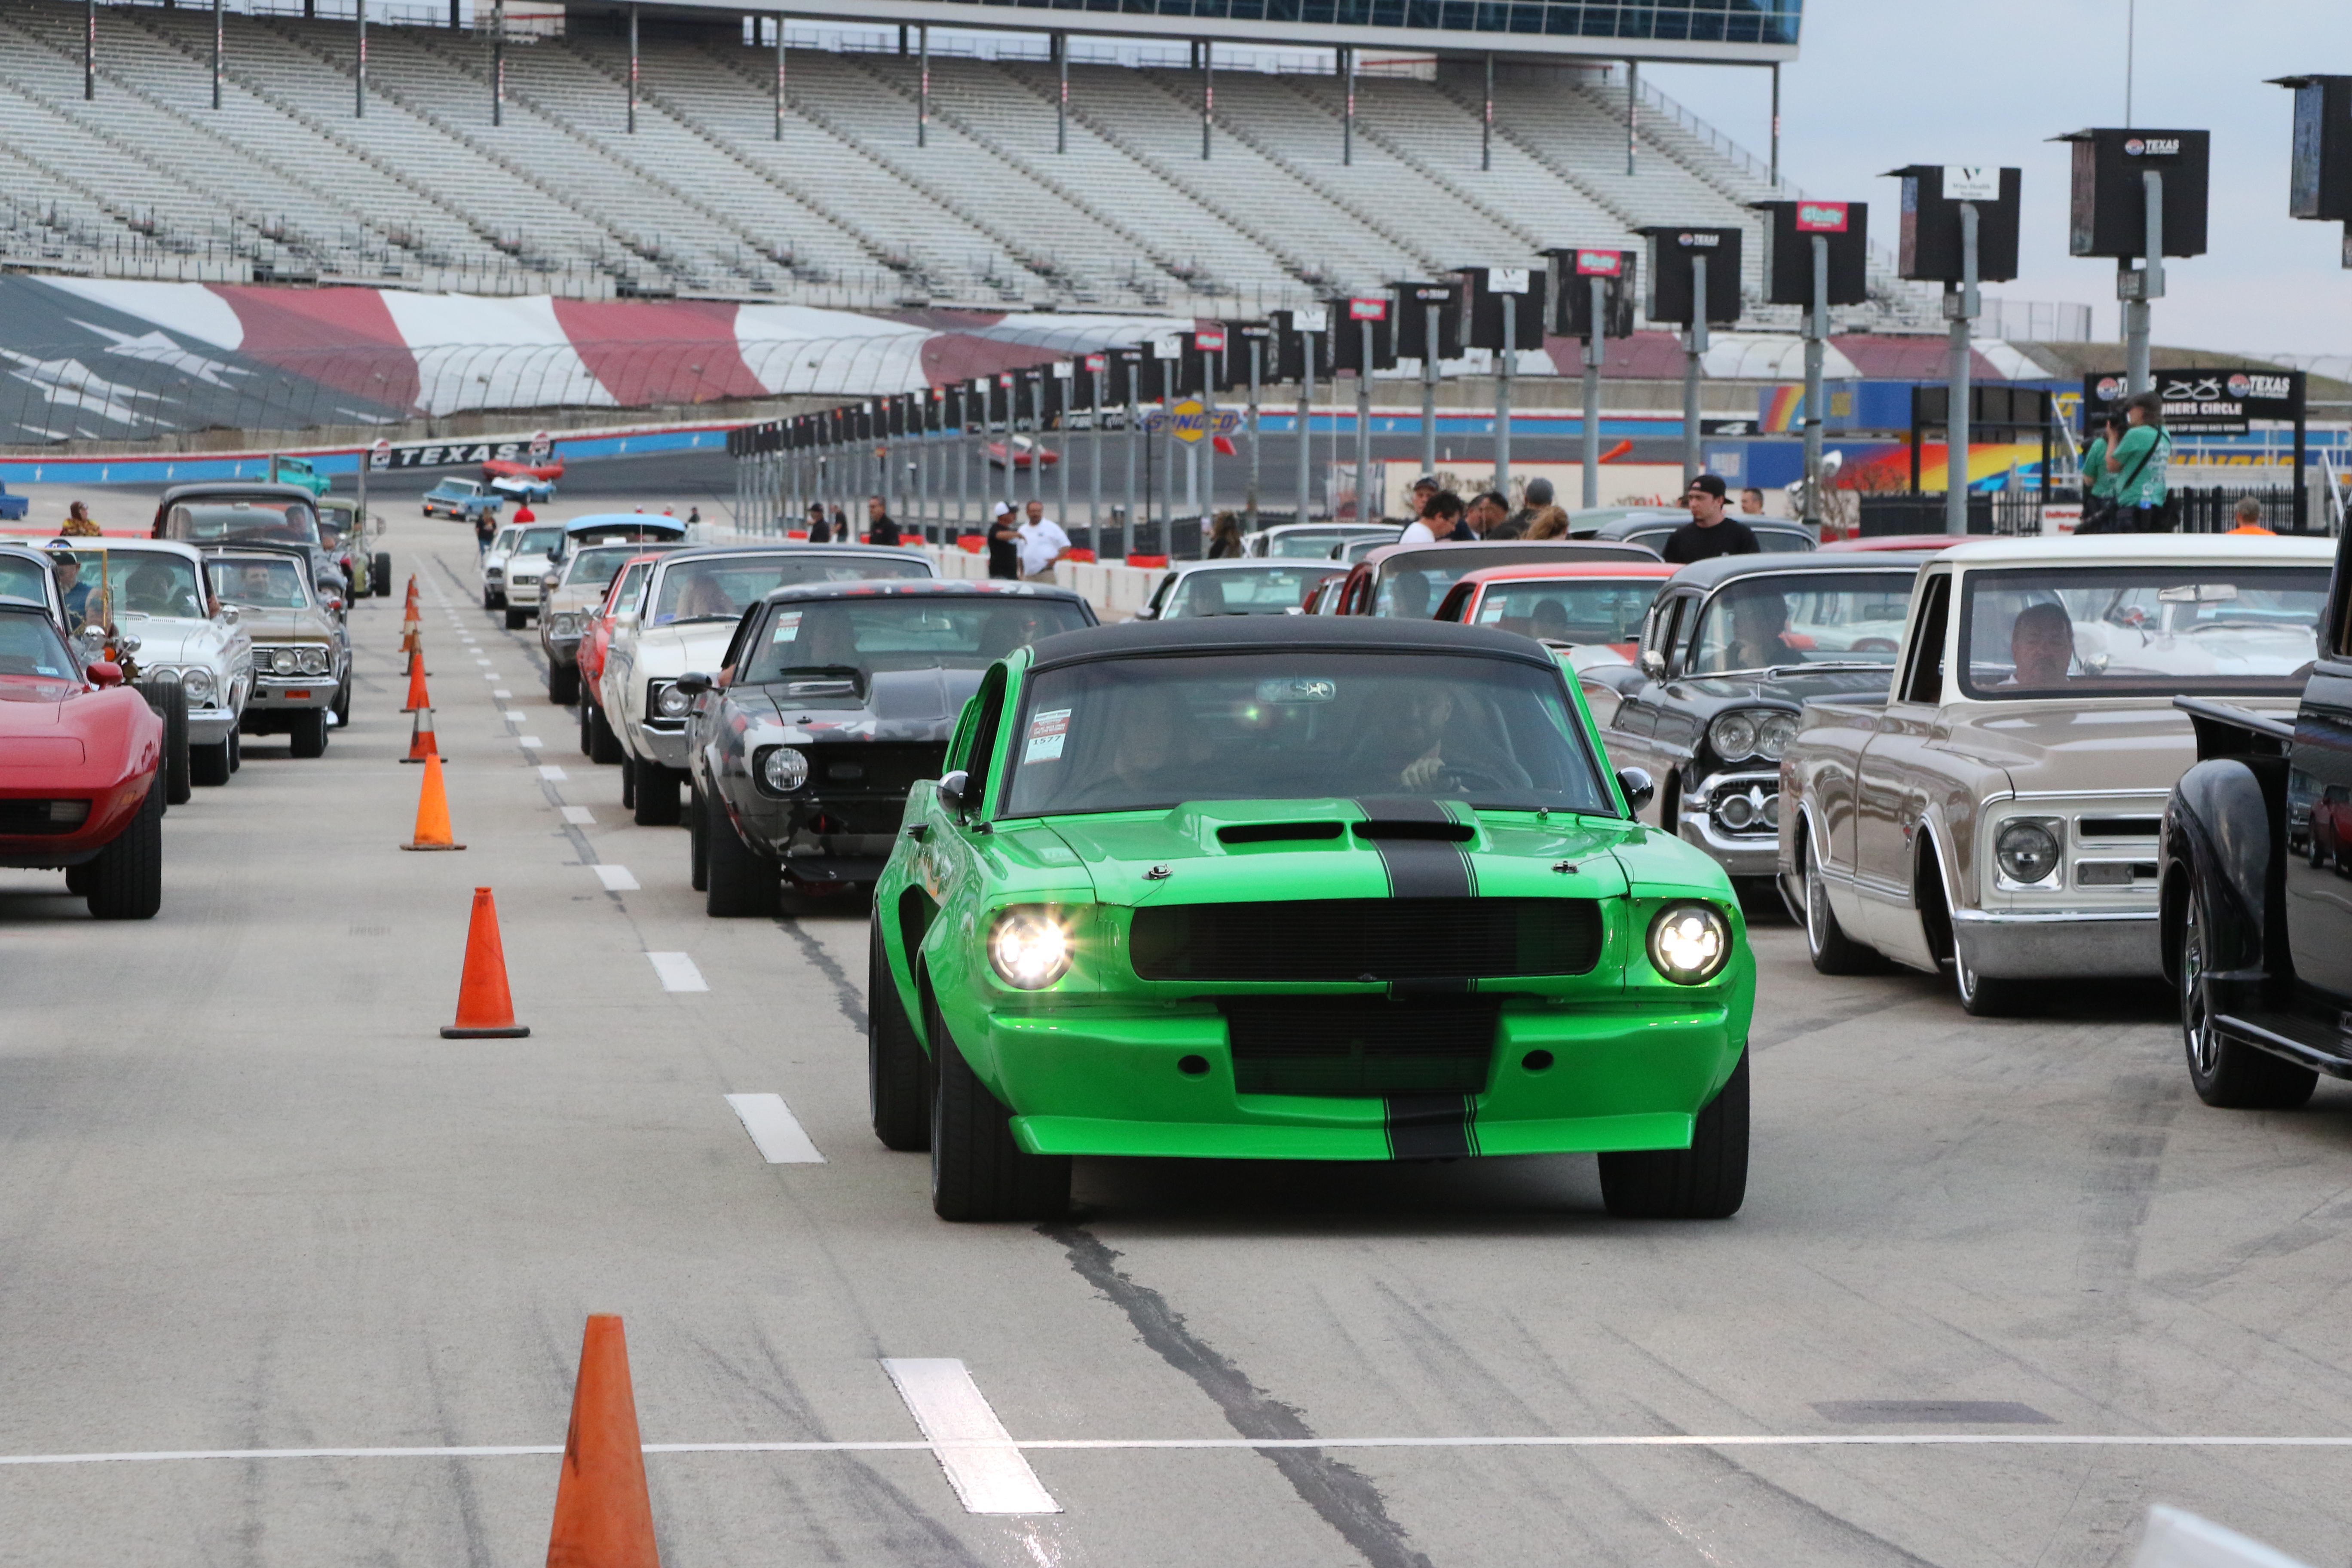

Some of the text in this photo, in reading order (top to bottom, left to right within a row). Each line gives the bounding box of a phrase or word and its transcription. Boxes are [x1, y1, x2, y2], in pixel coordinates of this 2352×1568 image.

[2145, 138, 2180, 150] TEXAS
[2249, 375, 2290, 394] TEXAS
[2200, 402, 2242, 415] CIRCLE
[400, 443, 520, 466] TEXAS
[1033, 735, 1061, 745] 1577
